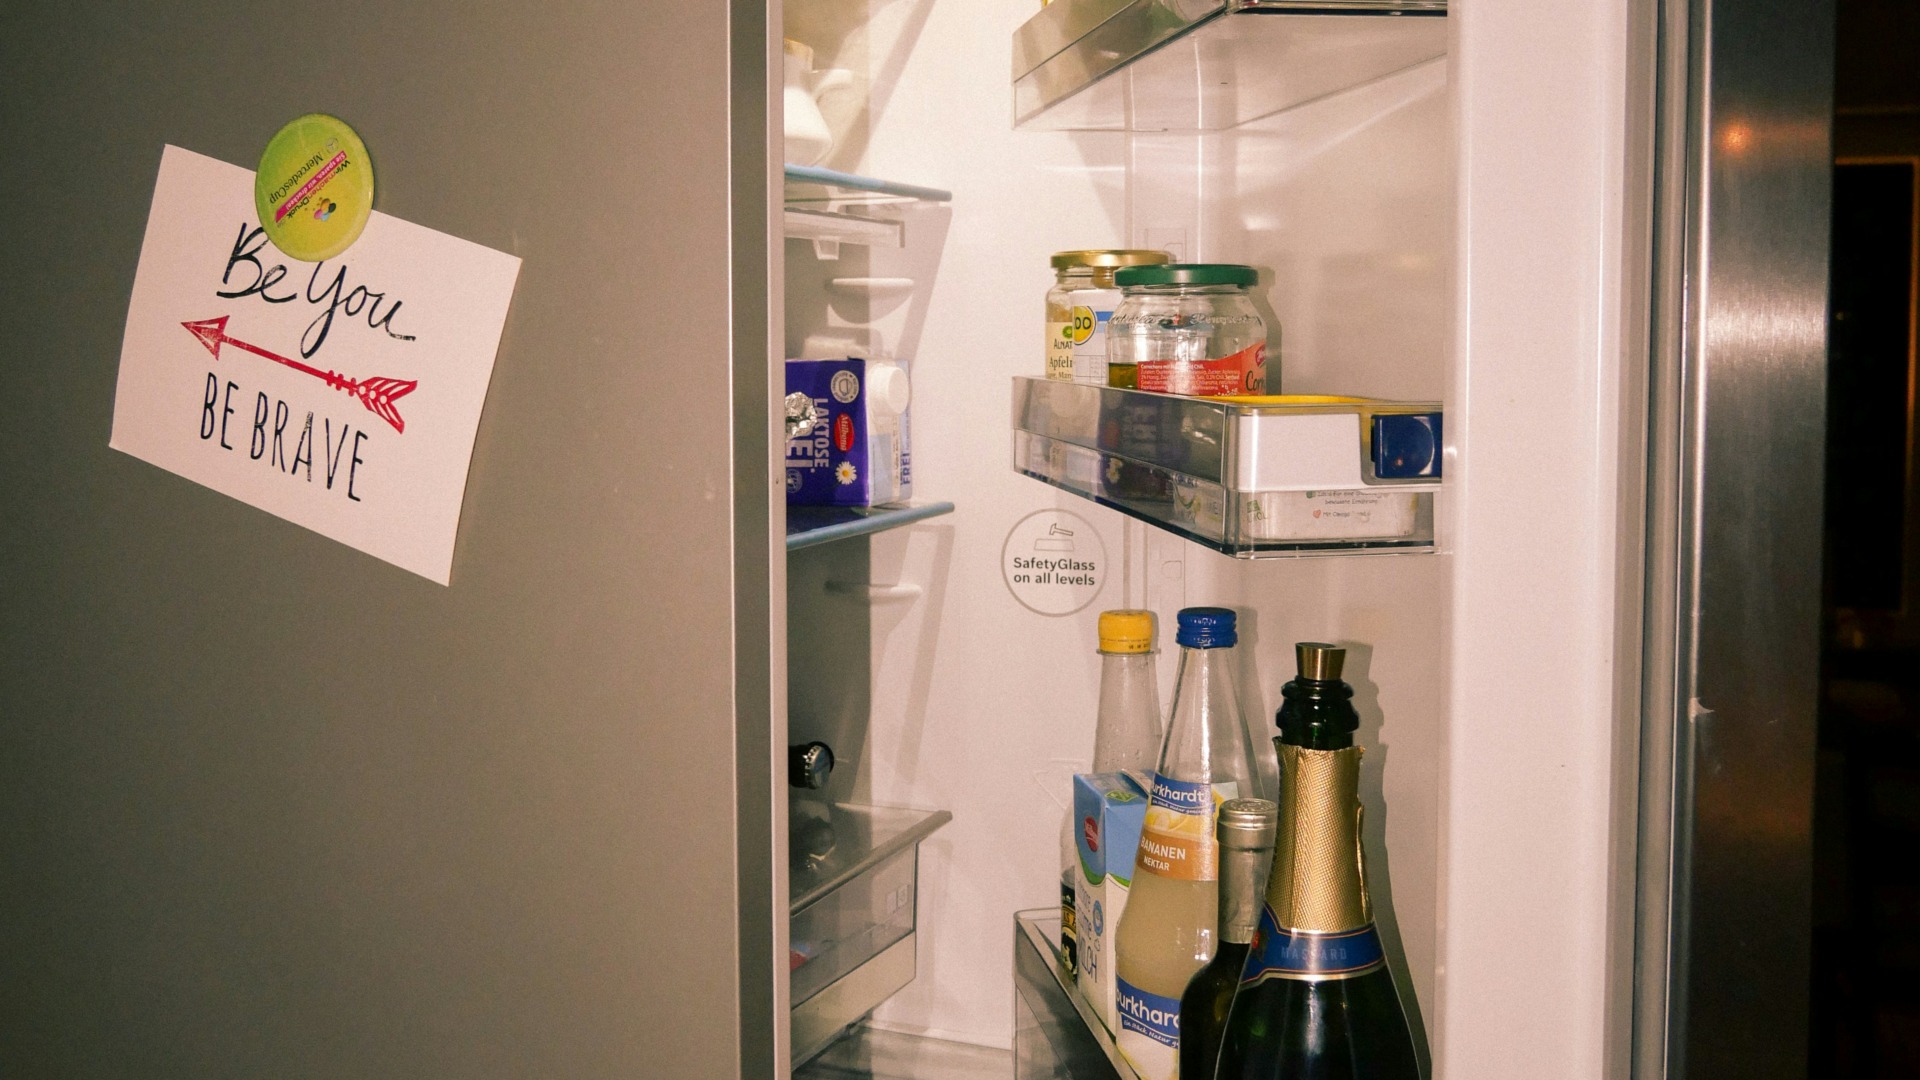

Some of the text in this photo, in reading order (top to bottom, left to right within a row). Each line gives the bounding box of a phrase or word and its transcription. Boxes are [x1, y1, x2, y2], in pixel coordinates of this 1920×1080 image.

[269, 151, 324, 204] MercedesCup
[216, 222, 297, 303] Be
[200, 371, 368, 502] BE BRAVE
[814, 398, 830, 468] LAKTOSE
[1014, 557, 1096, 572] SafetyGlass
[1014, 572, 1096, 586] on all levels
[1140, 836, 1186, 861] BANANEN
[1143, 855, 1170, 871] NEKTAR
